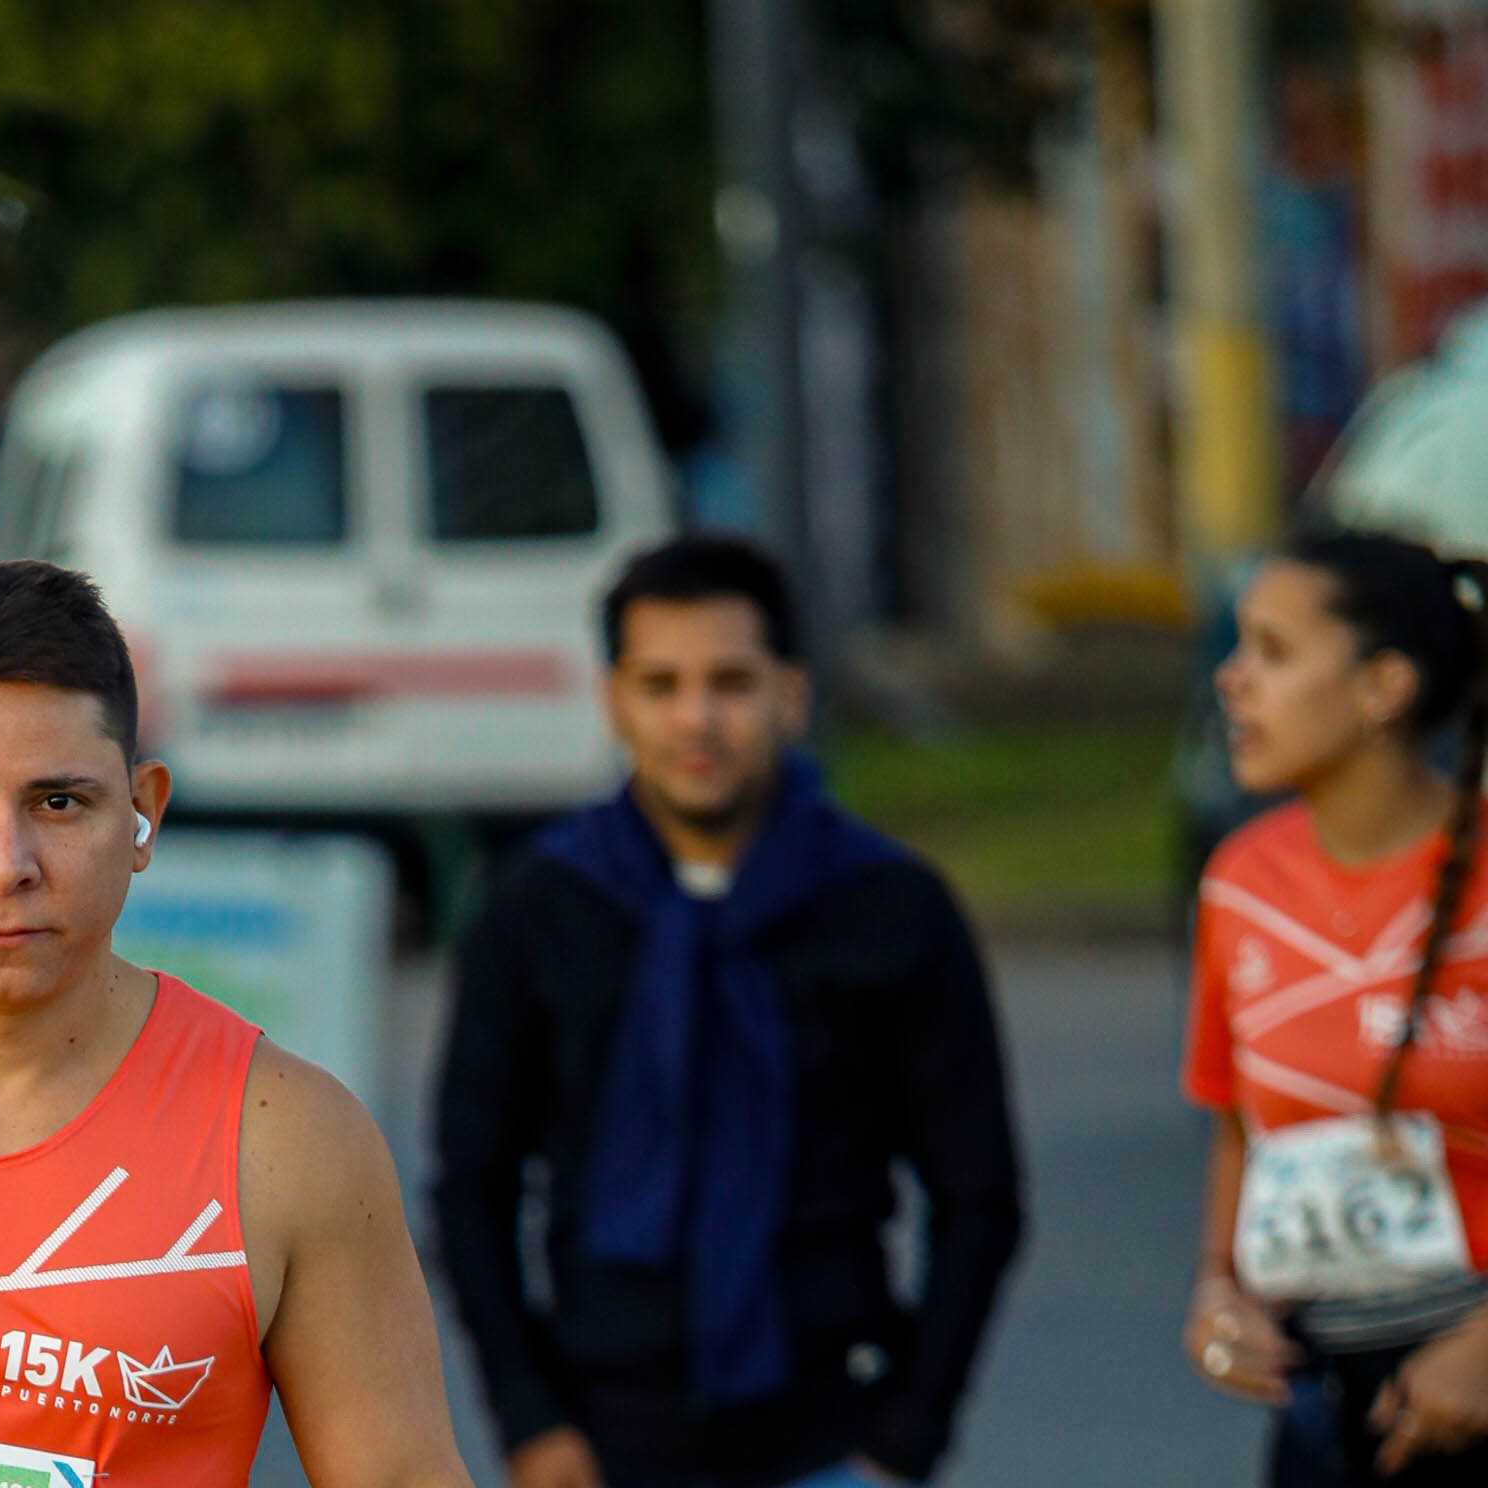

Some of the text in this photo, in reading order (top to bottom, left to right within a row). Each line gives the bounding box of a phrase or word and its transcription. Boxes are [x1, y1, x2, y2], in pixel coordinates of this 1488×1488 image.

[0, 1330, 111, 1398] 15K
[1, 1385, 177, 1425] PUERTO NORTE
